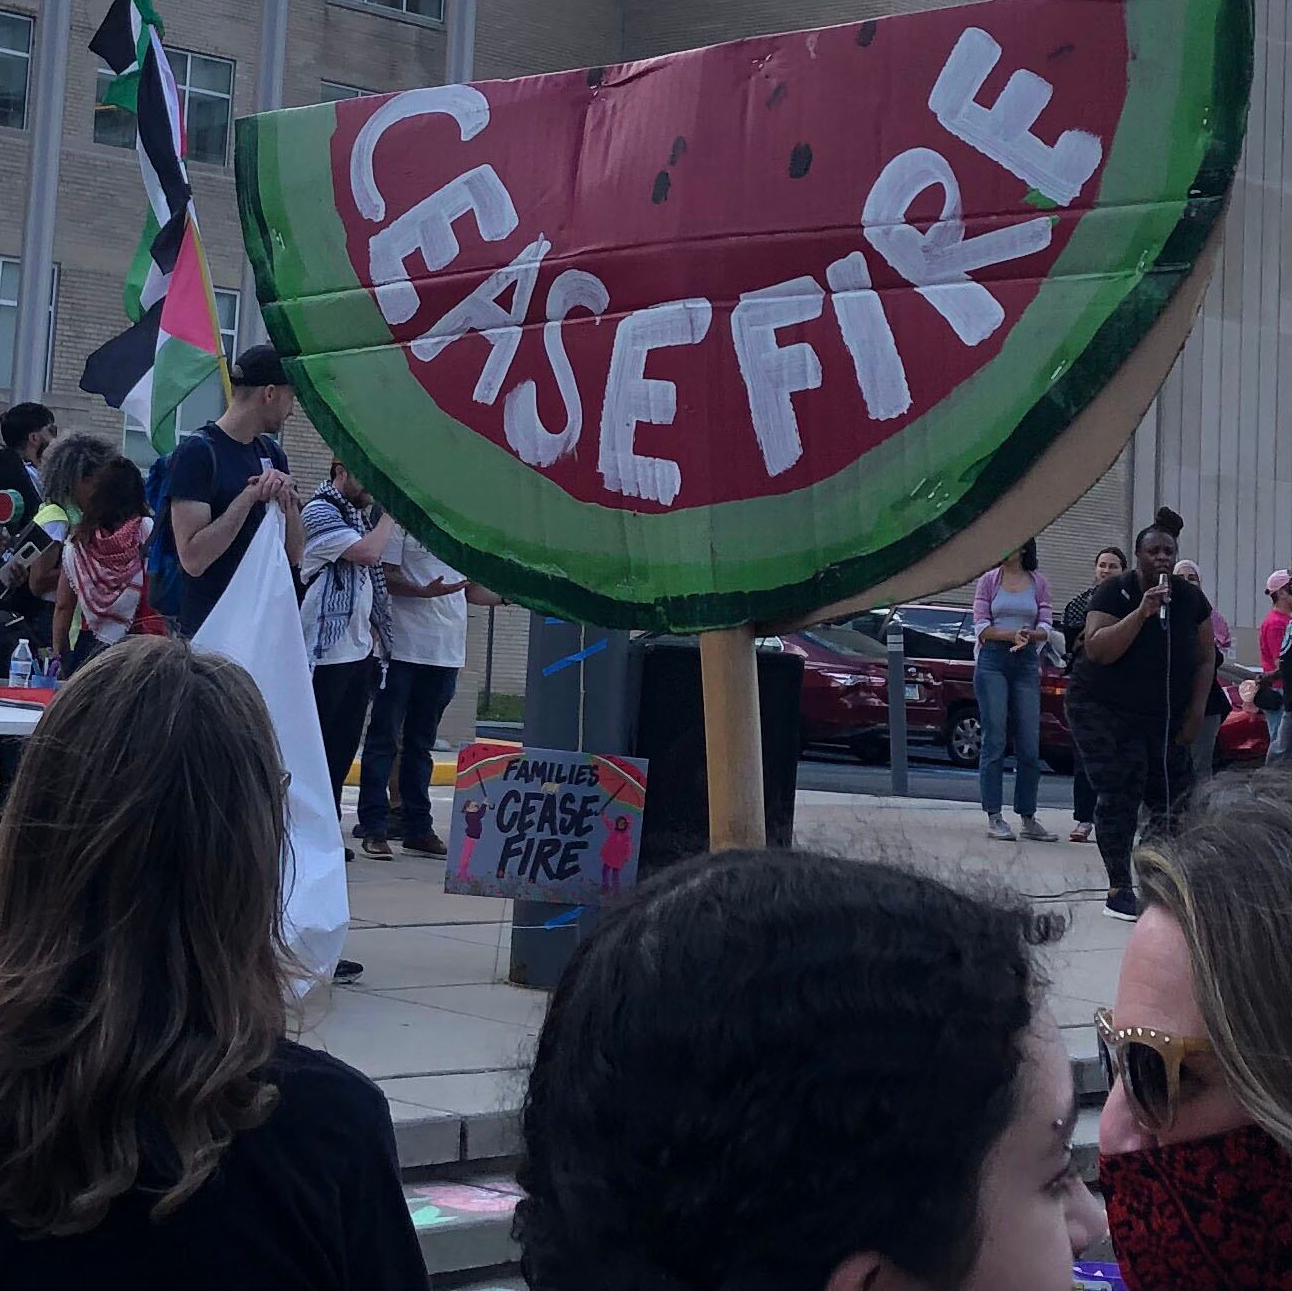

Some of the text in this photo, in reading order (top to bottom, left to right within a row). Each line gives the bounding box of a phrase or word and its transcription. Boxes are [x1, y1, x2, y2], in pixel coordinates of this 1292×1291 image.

[503, 758, 600, 787] FAMILIES
[496, 789, 600, 838] CEASE
[496, 832, 590, 884] FIRE
